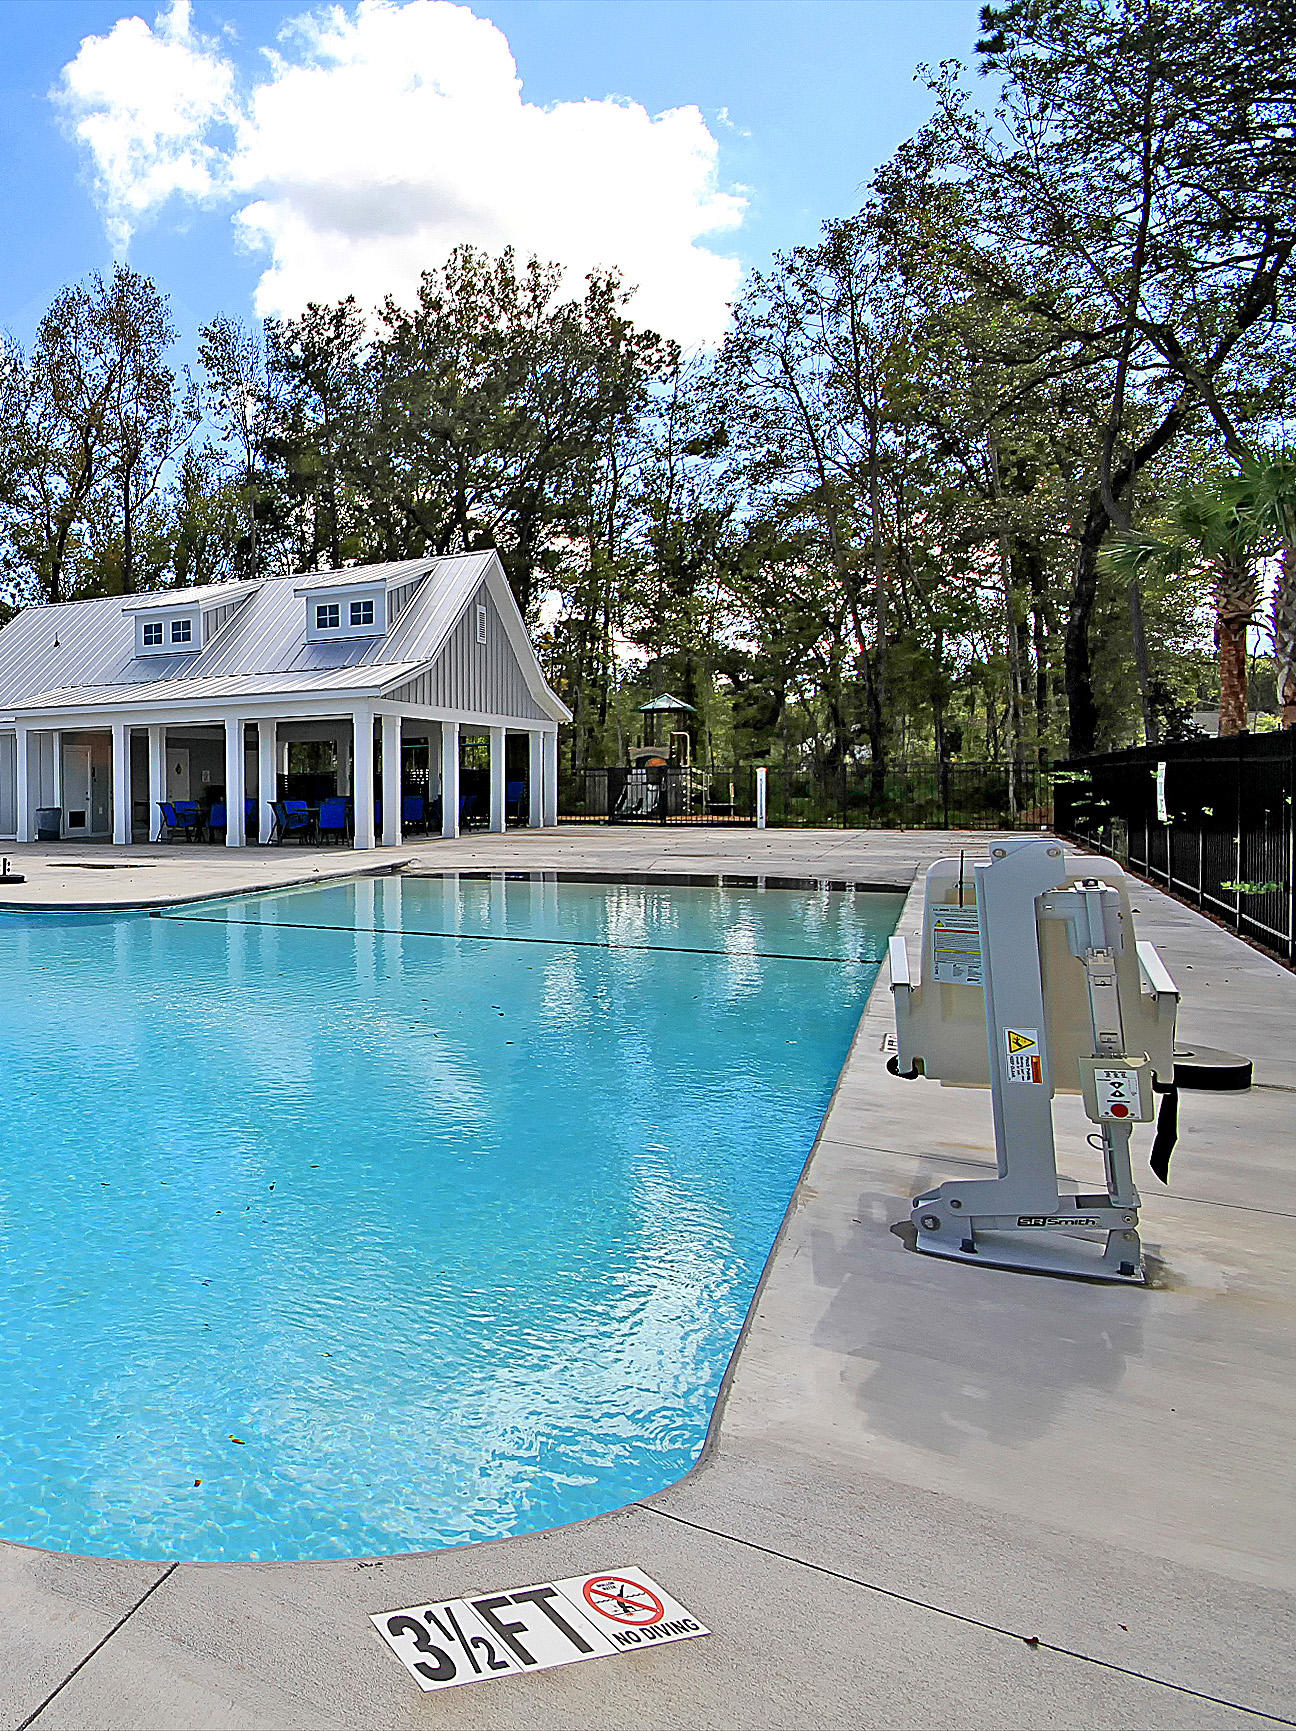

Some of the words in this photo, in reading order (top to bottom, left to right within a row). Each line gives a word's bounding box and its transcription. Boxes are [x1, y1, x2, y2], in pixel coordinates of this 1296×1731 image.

[1047, 1218, 1096, 1226] Smith
[472, 1587, 595, 1667] FT
[612, 1630, 642, 1646] NO
[639, 1618, 700, 1641] DIVING
